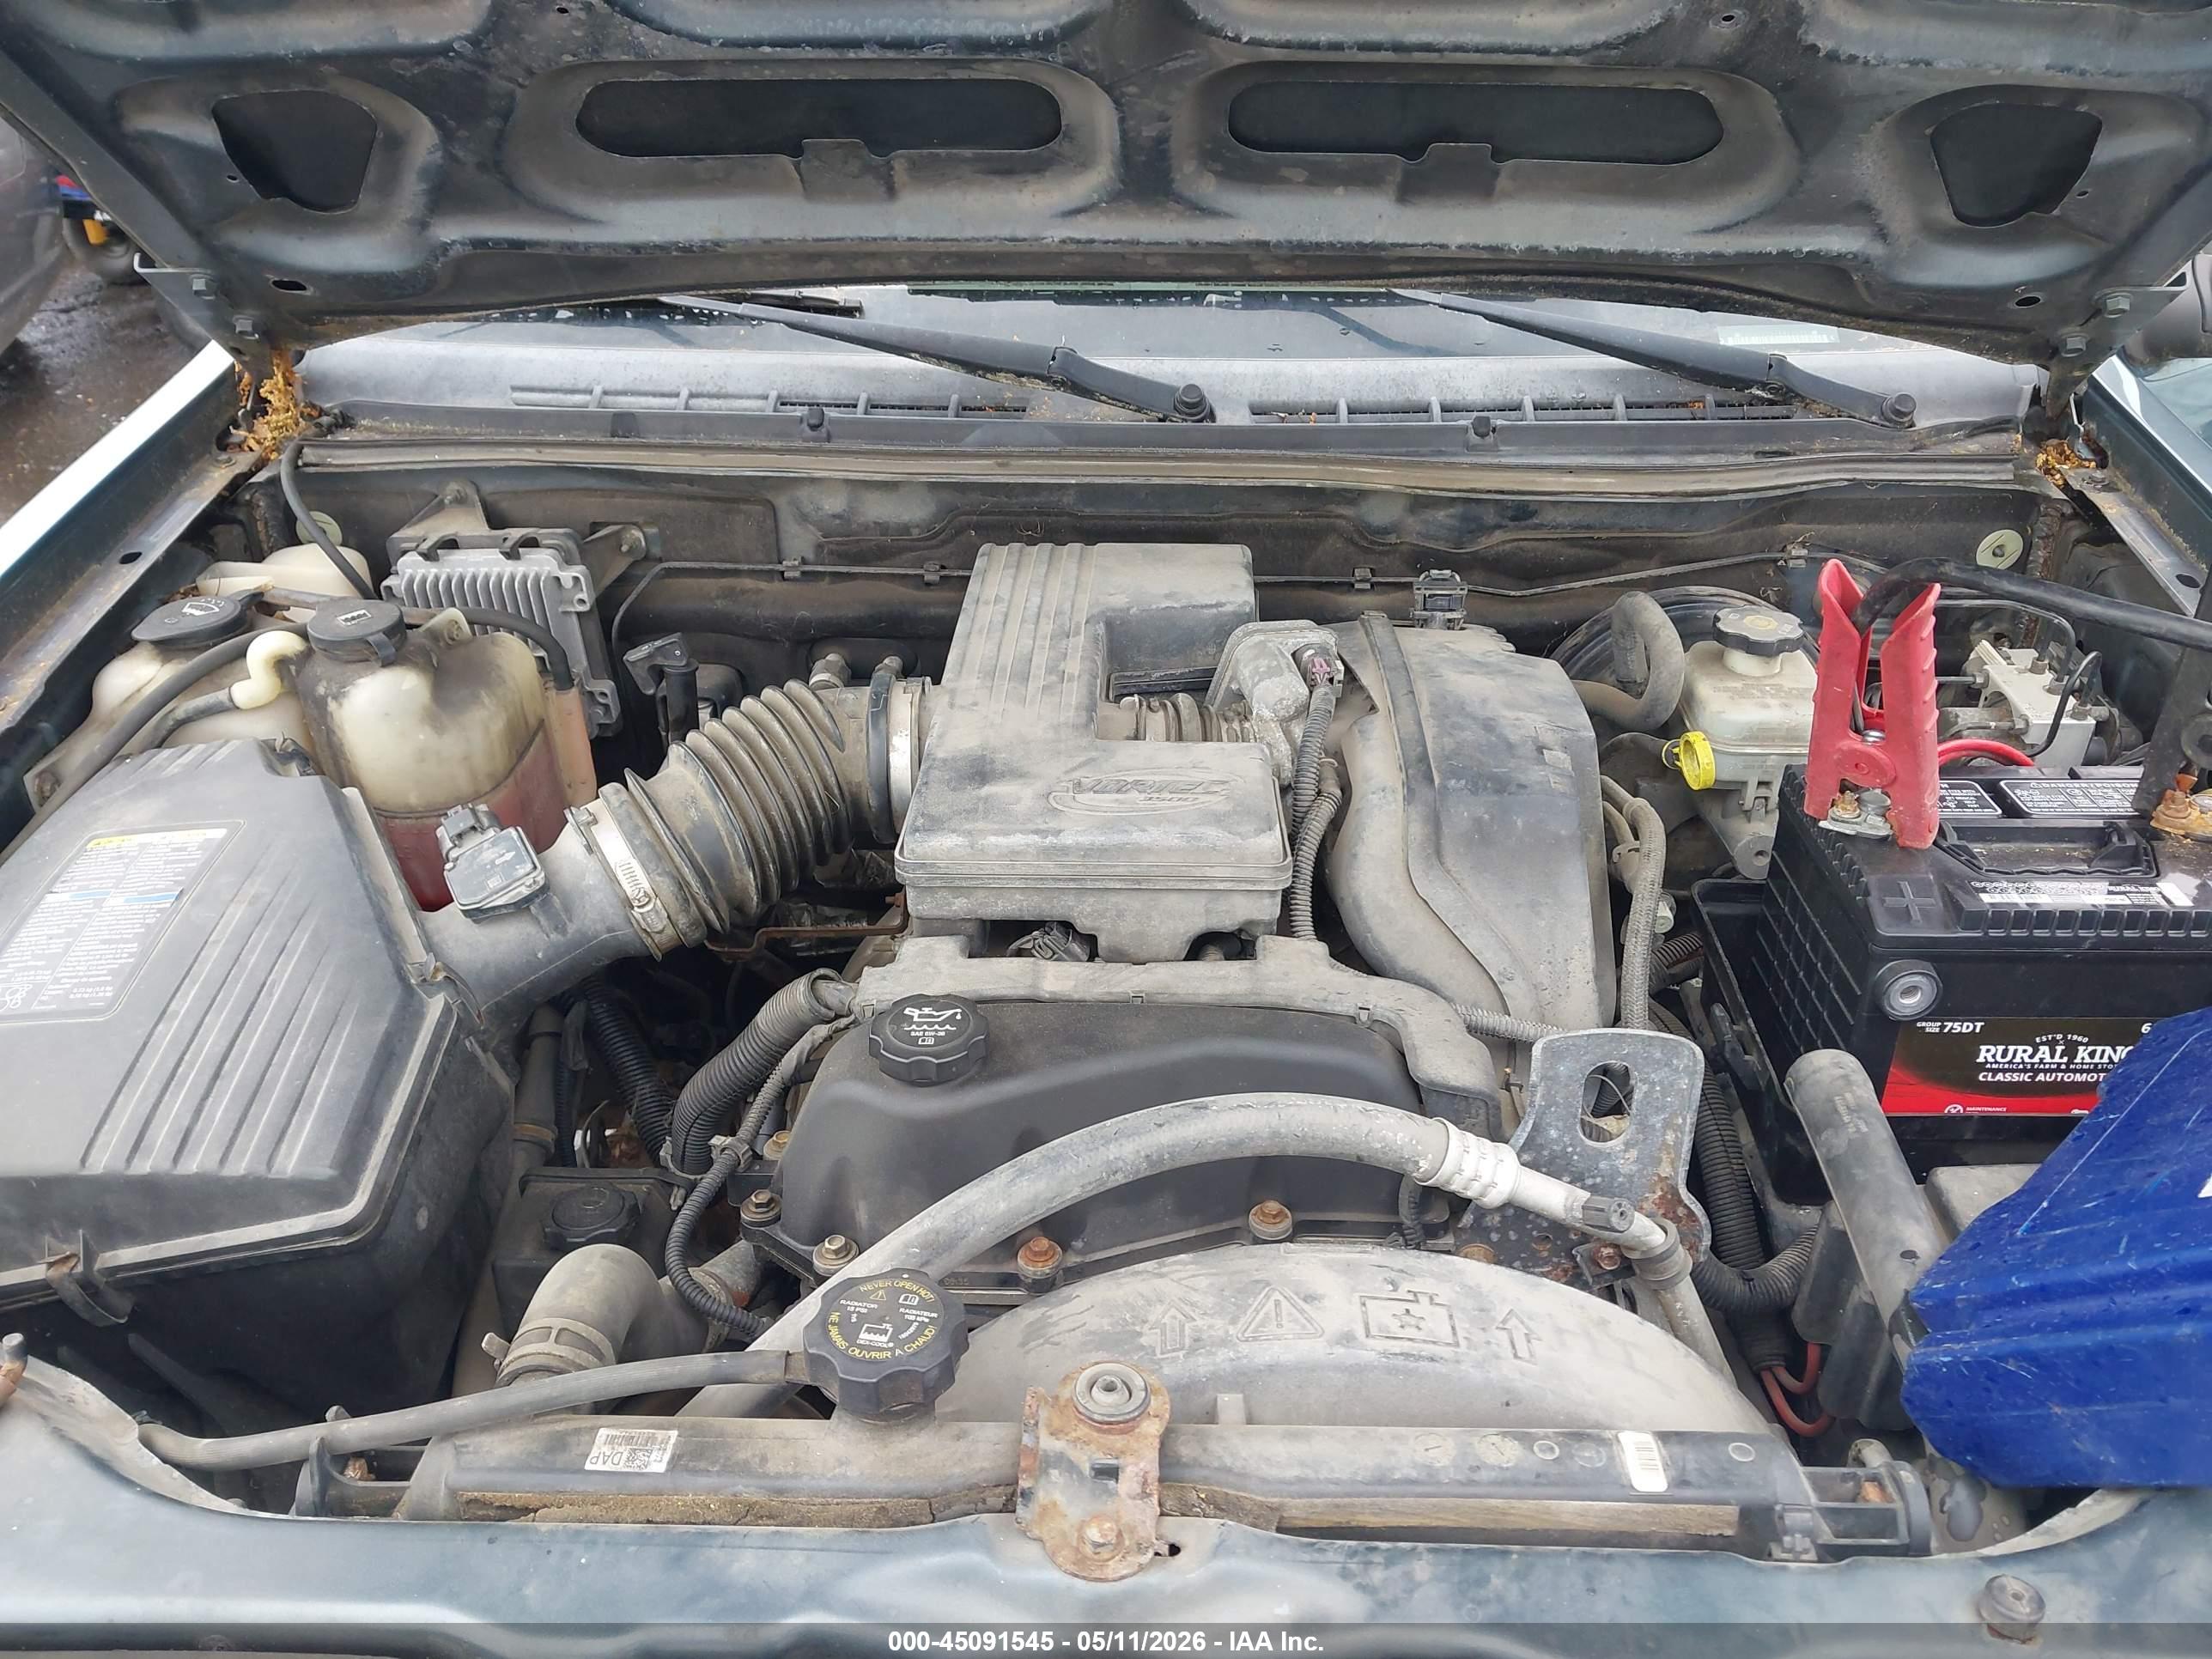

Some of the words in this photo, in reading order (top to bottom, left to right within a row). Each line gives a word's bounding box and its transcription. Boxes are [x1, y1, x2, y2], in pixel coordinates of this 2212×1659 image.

[1943, 1022, 1984, 1033] 75DT
[2035, 1034, 2063, 1043] EST'D
[2067, 1034, 2089, 1043] 1960
[1975, 1045, 2069, 1064] RURAL
[1978, 1073, 2033, 1082] CLASSIC
[860, 1280, 893, 1292] NEVER
[893, 1279, 918, 1292] OPEN
[917, 1285, 935, 1303] HOT!
[840, 1299, 878, 1309] RADIATOR
[828, 1312, 841, 1323] NE
[899, 1308, 939, 1318] RADIATEUR
[828, 1324, 849, 1350] JAMAIS
[903, 1325, 938, 1352] CHAUD!
[848, 1346, 893, 1359] OUVRIR
[589, 1451, 624, 1466] DAP
